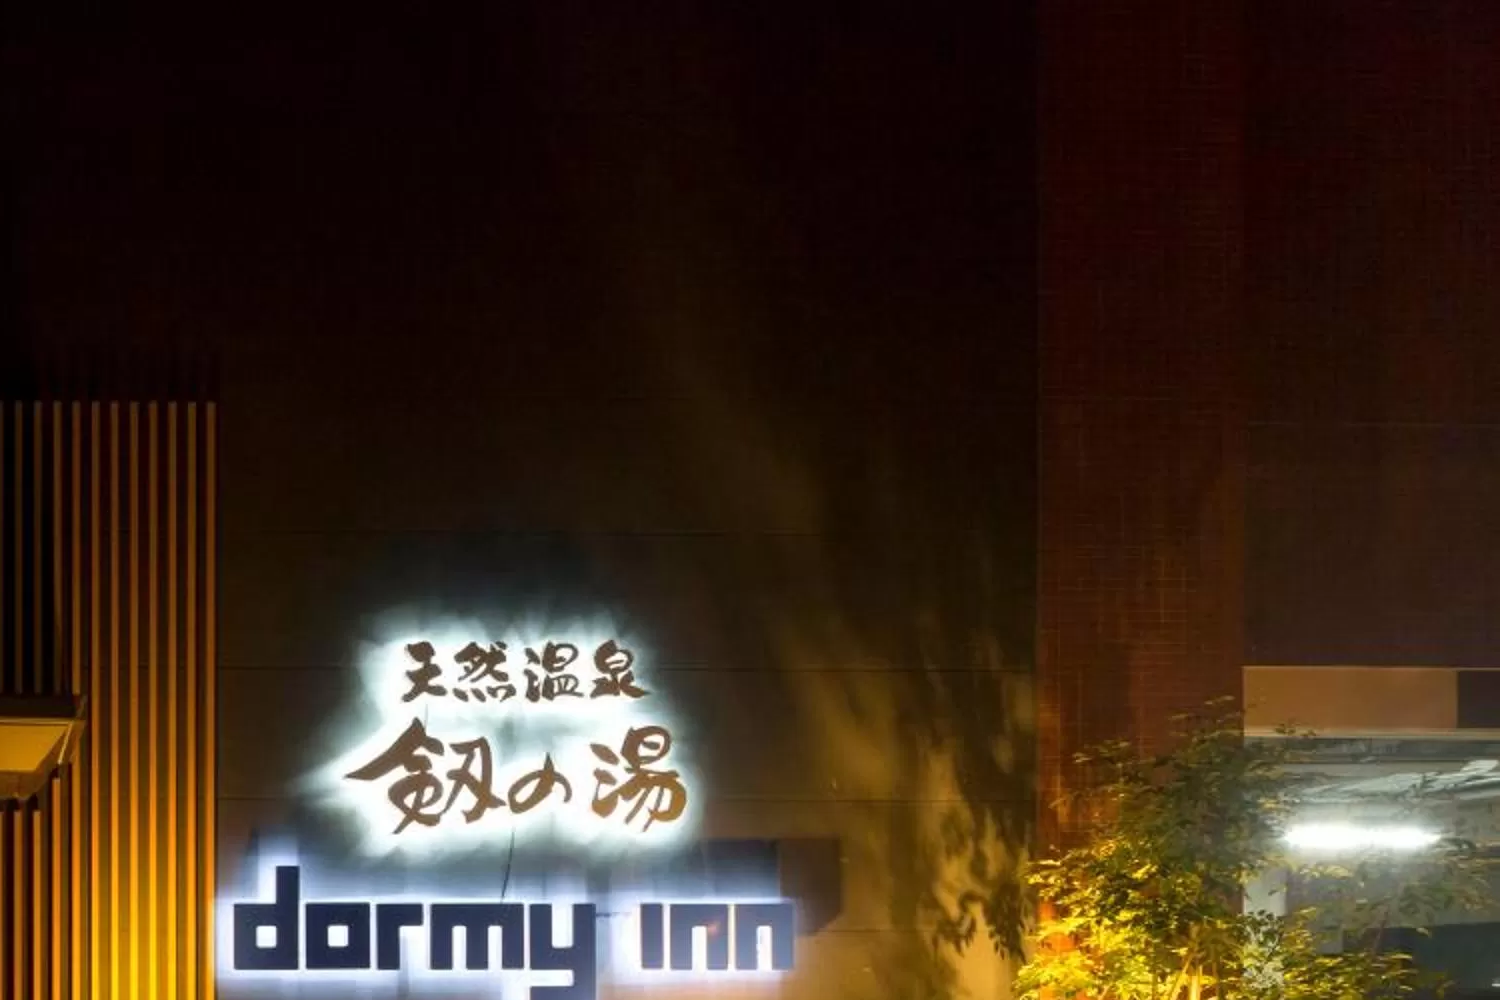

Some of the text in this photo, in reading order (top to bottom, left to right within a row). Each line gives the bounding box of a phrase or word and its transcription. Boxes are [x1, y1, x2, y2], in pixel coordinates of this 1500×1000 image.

[402, 640, 650, 703] 天然温泉
[640, 902, 794, 971] inn
